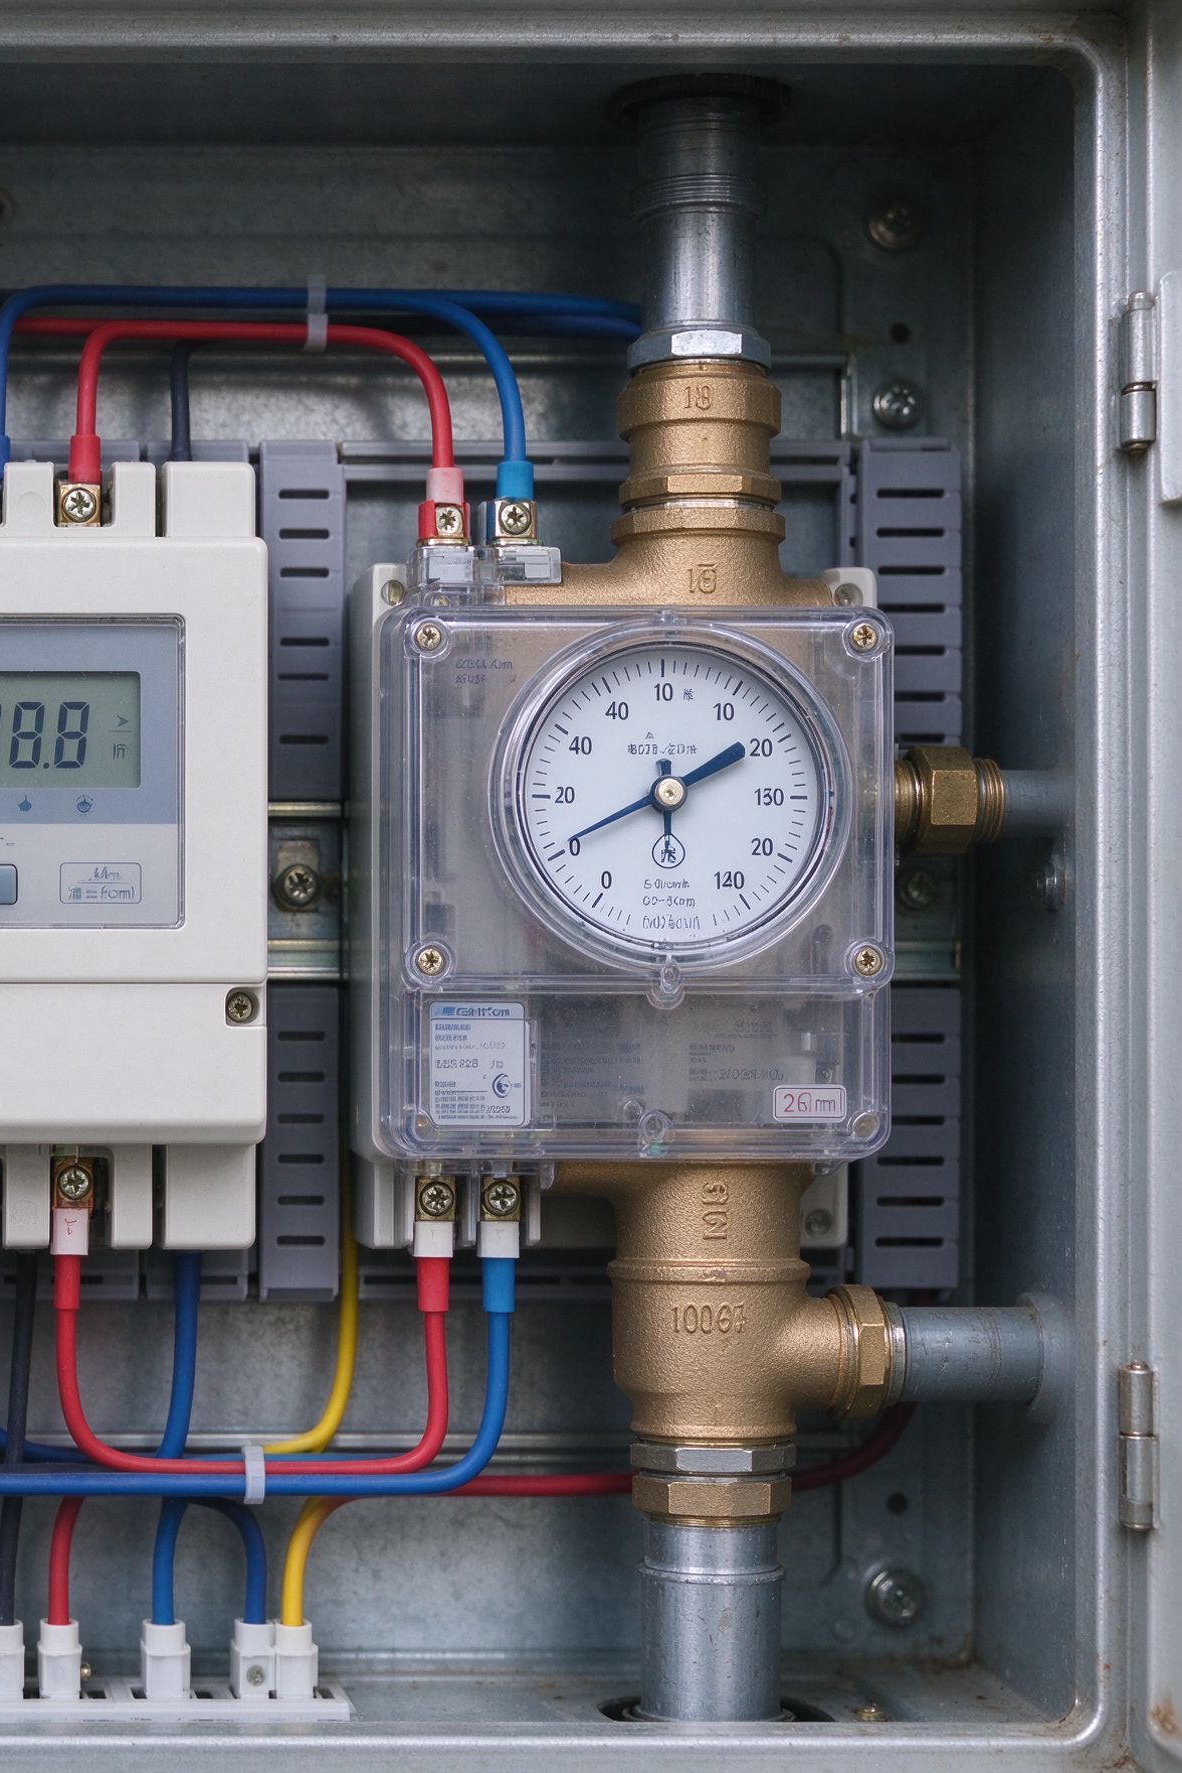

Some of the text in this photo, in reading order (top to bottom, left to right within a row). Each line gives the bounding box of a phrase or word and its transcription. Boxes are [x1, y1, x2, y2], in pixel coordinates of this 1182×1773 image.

[653, 682, 674, 702] 10
[605, 702, 630, 721] 40
[713, 702, 735, 722] 10
[568, 736, 593, 756] 40
[749, 738, 773, 758] 20
[554, 786, 576, 805] 20
[751, 837, 774, 857] 20
[600, 870, 613, 890] 0
